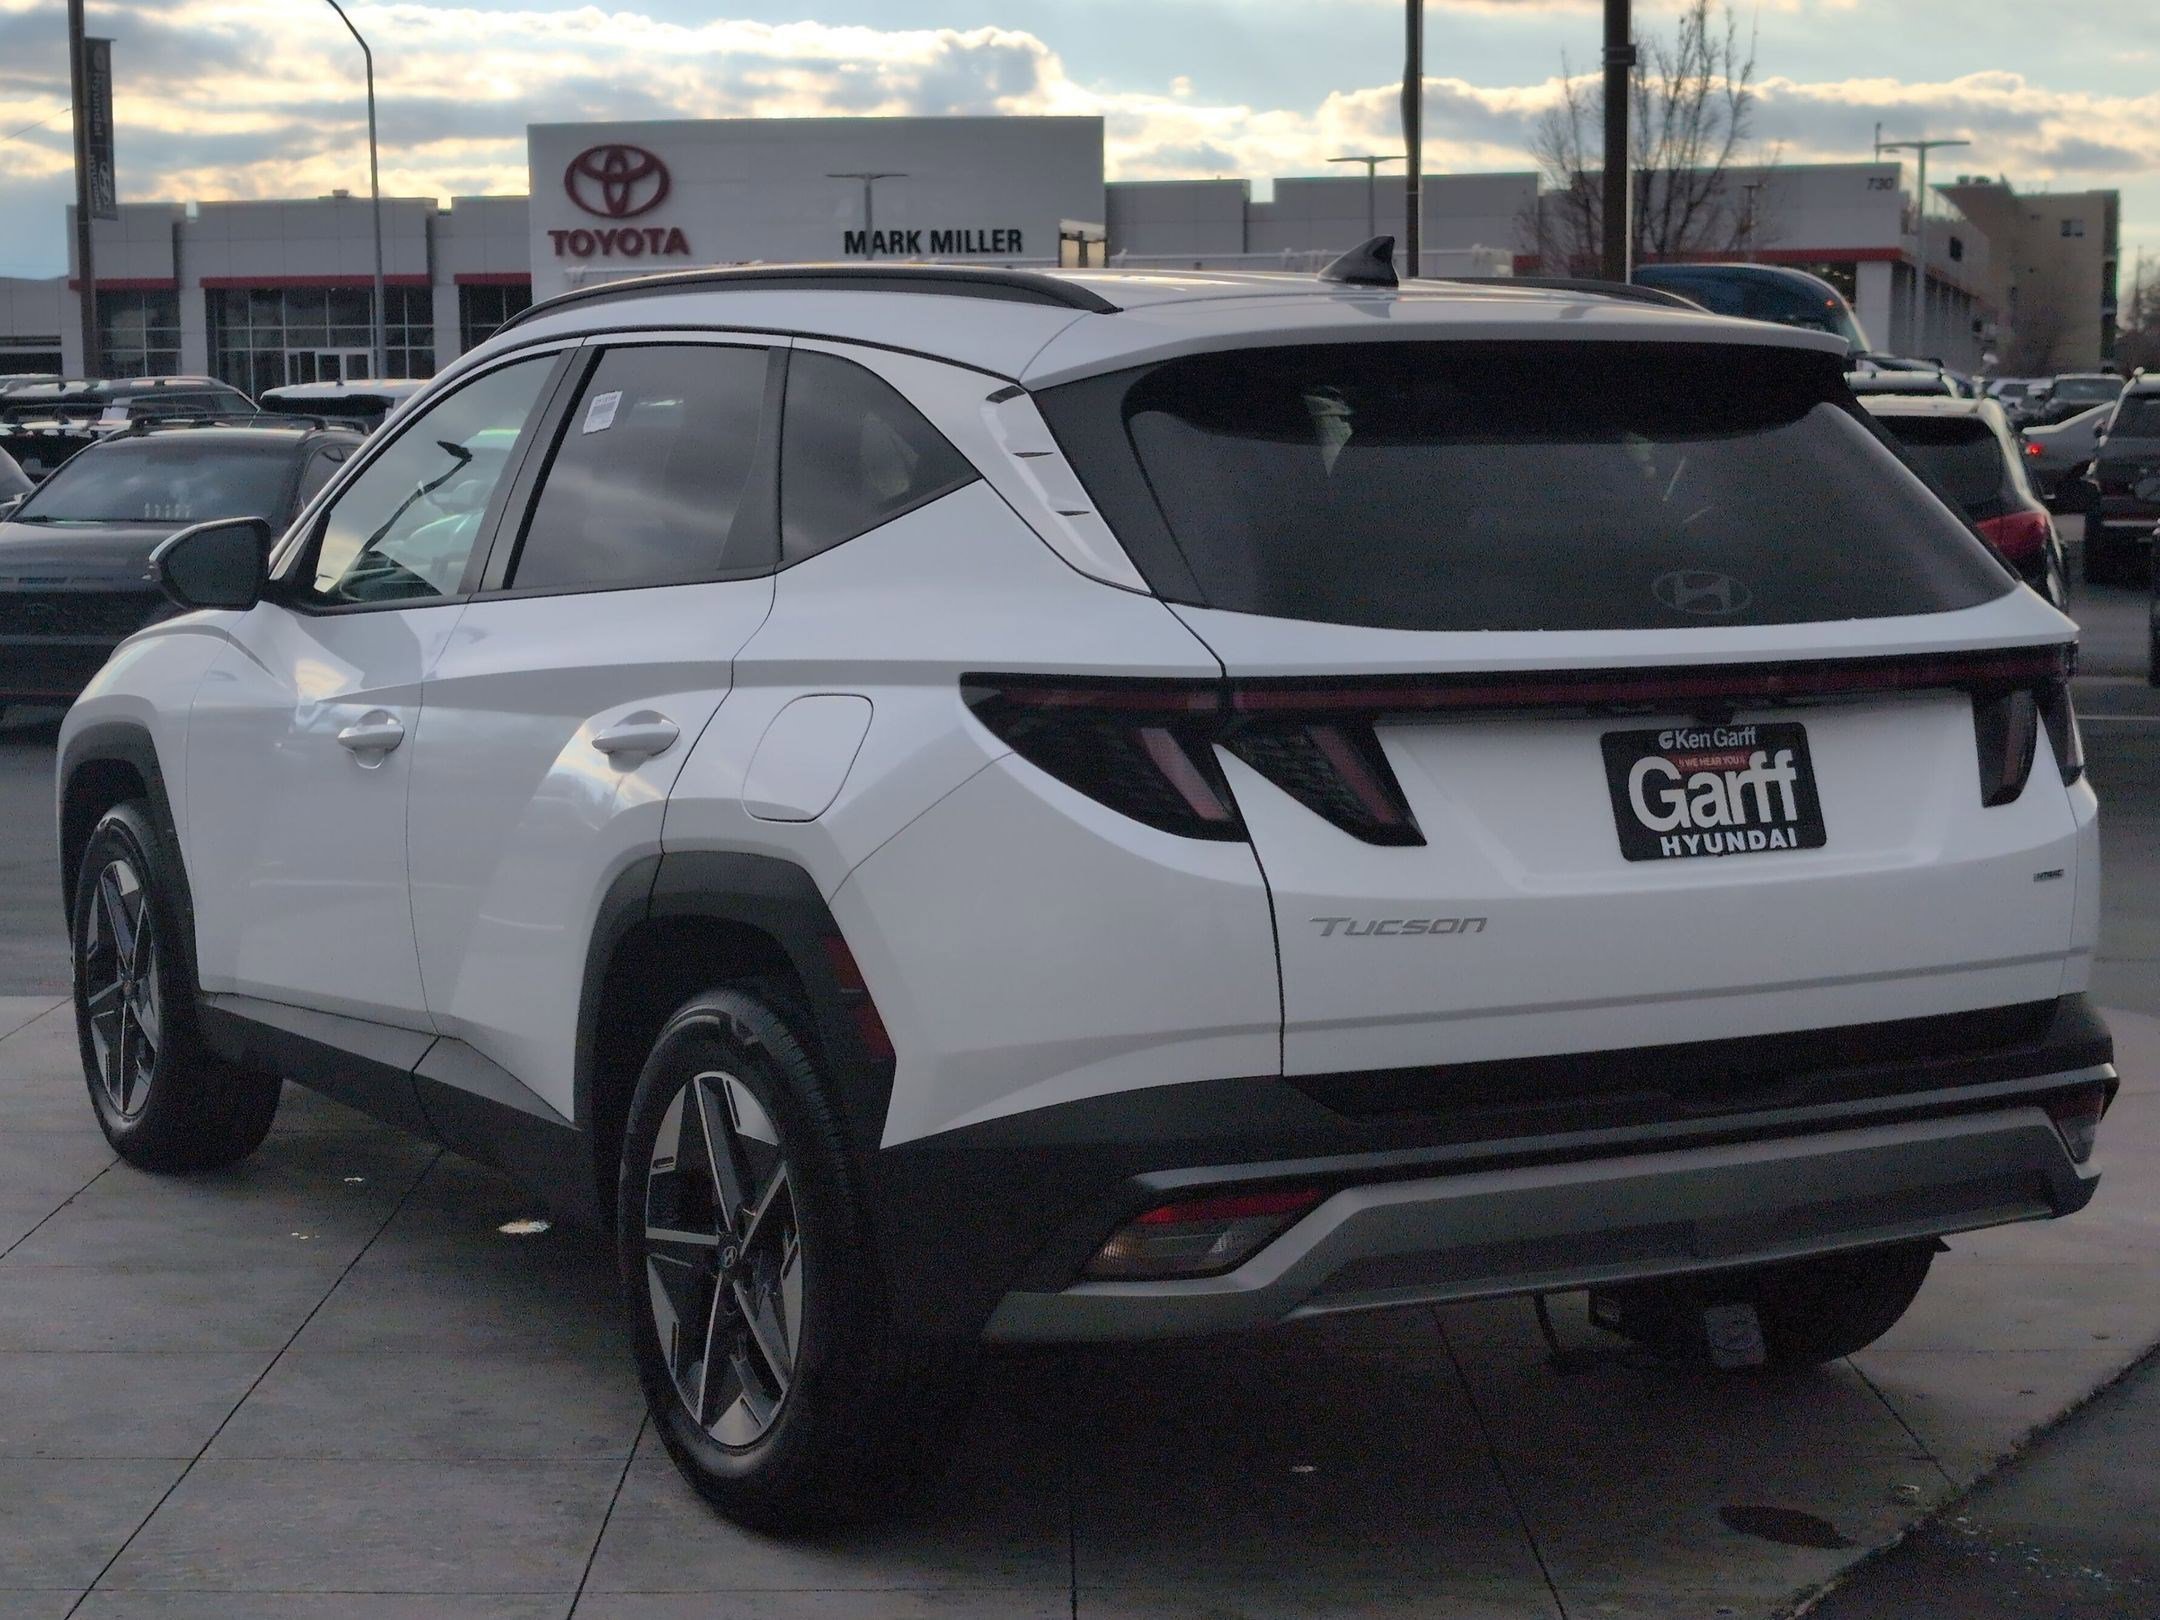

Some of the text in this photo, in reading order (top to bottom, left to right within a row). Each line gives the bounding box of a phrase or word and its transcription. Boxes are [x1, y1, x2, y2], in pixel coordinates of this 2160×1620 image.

[1867, 177, 1895, 190] 730
[547, 227, 691, 258] TOYOTA
[843, 229, 1023, 255] MARK MILLER
[1675, 729, 1711, 749] Ken
[1713, 727, 1757, 748] Garff
[1699, 756, 1722, 766] HEAR
[1628, 749, 1798, 832] Garff
[1660, 827, 1798, 857] HYUNDAI
